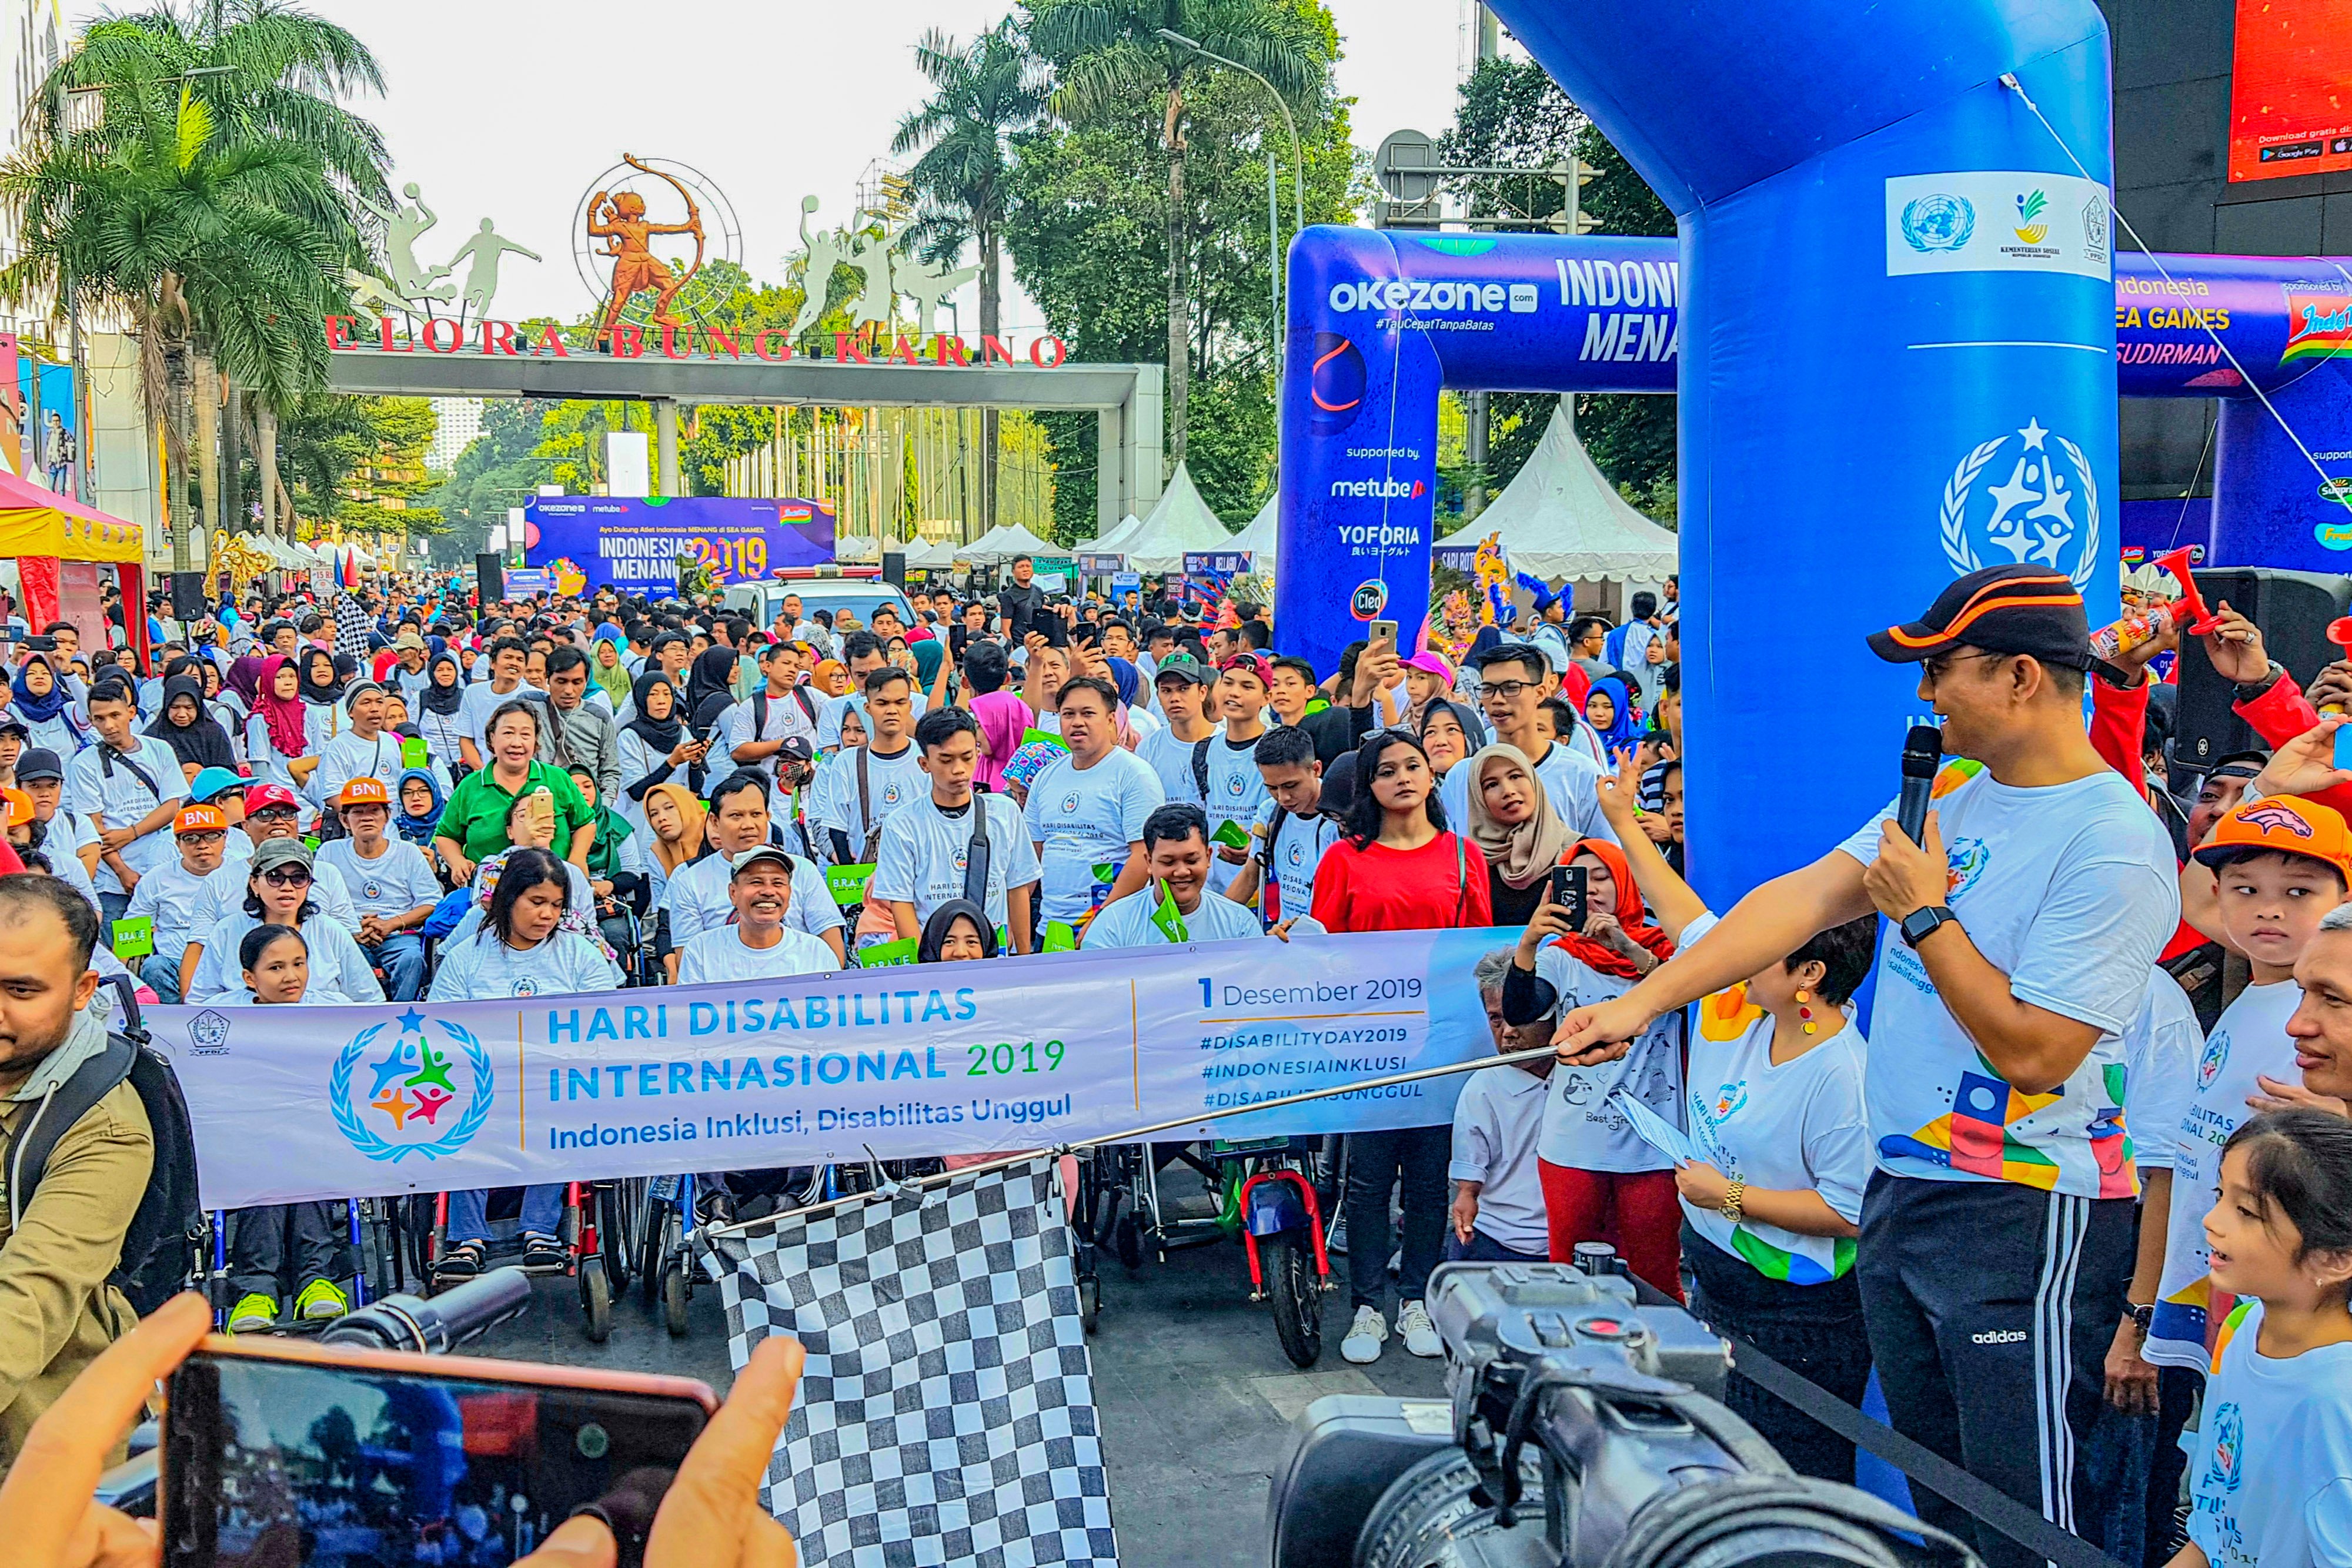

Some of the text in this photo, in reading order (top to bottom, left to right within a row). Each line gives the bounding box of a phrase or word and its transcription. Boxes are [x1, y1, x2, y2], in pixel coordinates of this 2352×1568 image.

[2259, 131, 2306, 143] Download
[2310, 127, 2336, 138] gratis
[2283, 282, 2331, 292] sponsored
[1376, 318, 1494, 331] #TauCepatTanpaBatas
[2149, 307, 2230, 329] GAMES
[266, 315, 1066, 369] ELORA BUNG KARNO
[2116, 343, 2221, 365] SUDIRMAN
[1346, 447, 1404, 459] supported
[1331, 477, 1410, 497] metube
[1338, 526, 1419, 545] YOFORIA
[1358, 593, 1381, 609] Cleo
[352, 784, 380, 797] BNI
[184, 811, 215, 826] BNI
[1198, 978, 1422, 1008] 1 Desember 2019
[549, 987, 977, 1044] HARI DISABILITAS
[1200, 1028, 1407, 1050] #DISABILITYDAY2019
[549, 1039, 1065, 1102] INTERNASIONAL 2019
[1201, 1057, 1406, 1078] #INDONESIAINKLUSI
[550, 1093, 1071, 1150] Indonesia Inklusi, Disabilitas Unggul
[1586, 1112, 1608, 1124] Best
[1972, 1329, 2026, 1344] adidas
